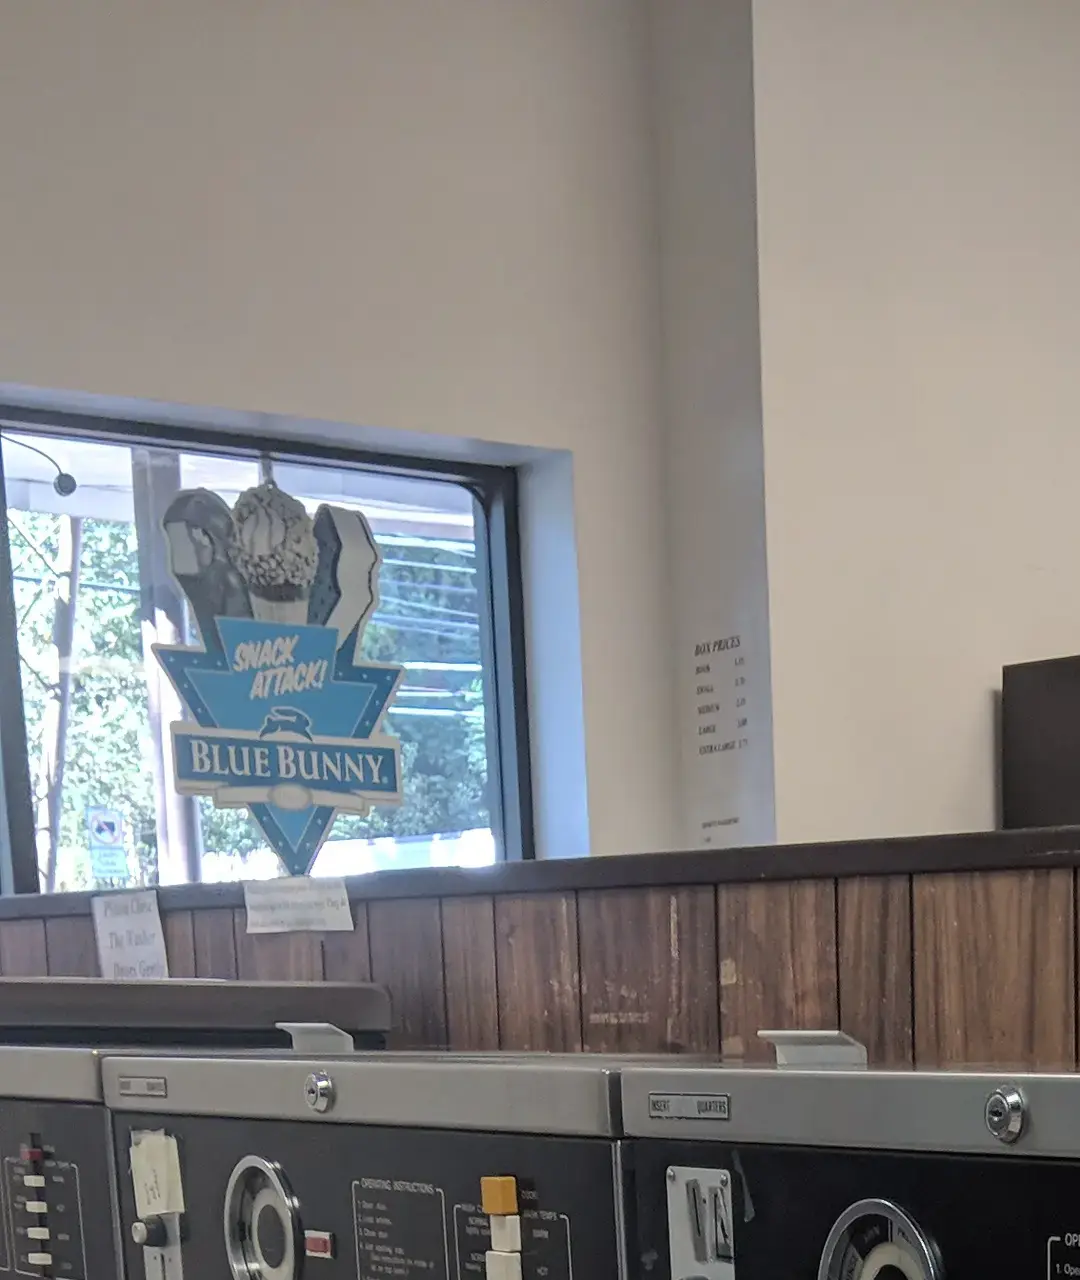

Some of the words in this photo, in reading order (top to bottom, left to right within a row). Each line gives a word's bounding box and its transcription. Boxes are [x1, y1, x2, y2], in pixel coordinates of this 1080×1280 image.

[233, 634, 299, 672] SNACK
[249, 659, 328, 700] ATTACK!
[190, 739, 271, 778] BLUE
[276, 744, 385, 785] BUNNY
